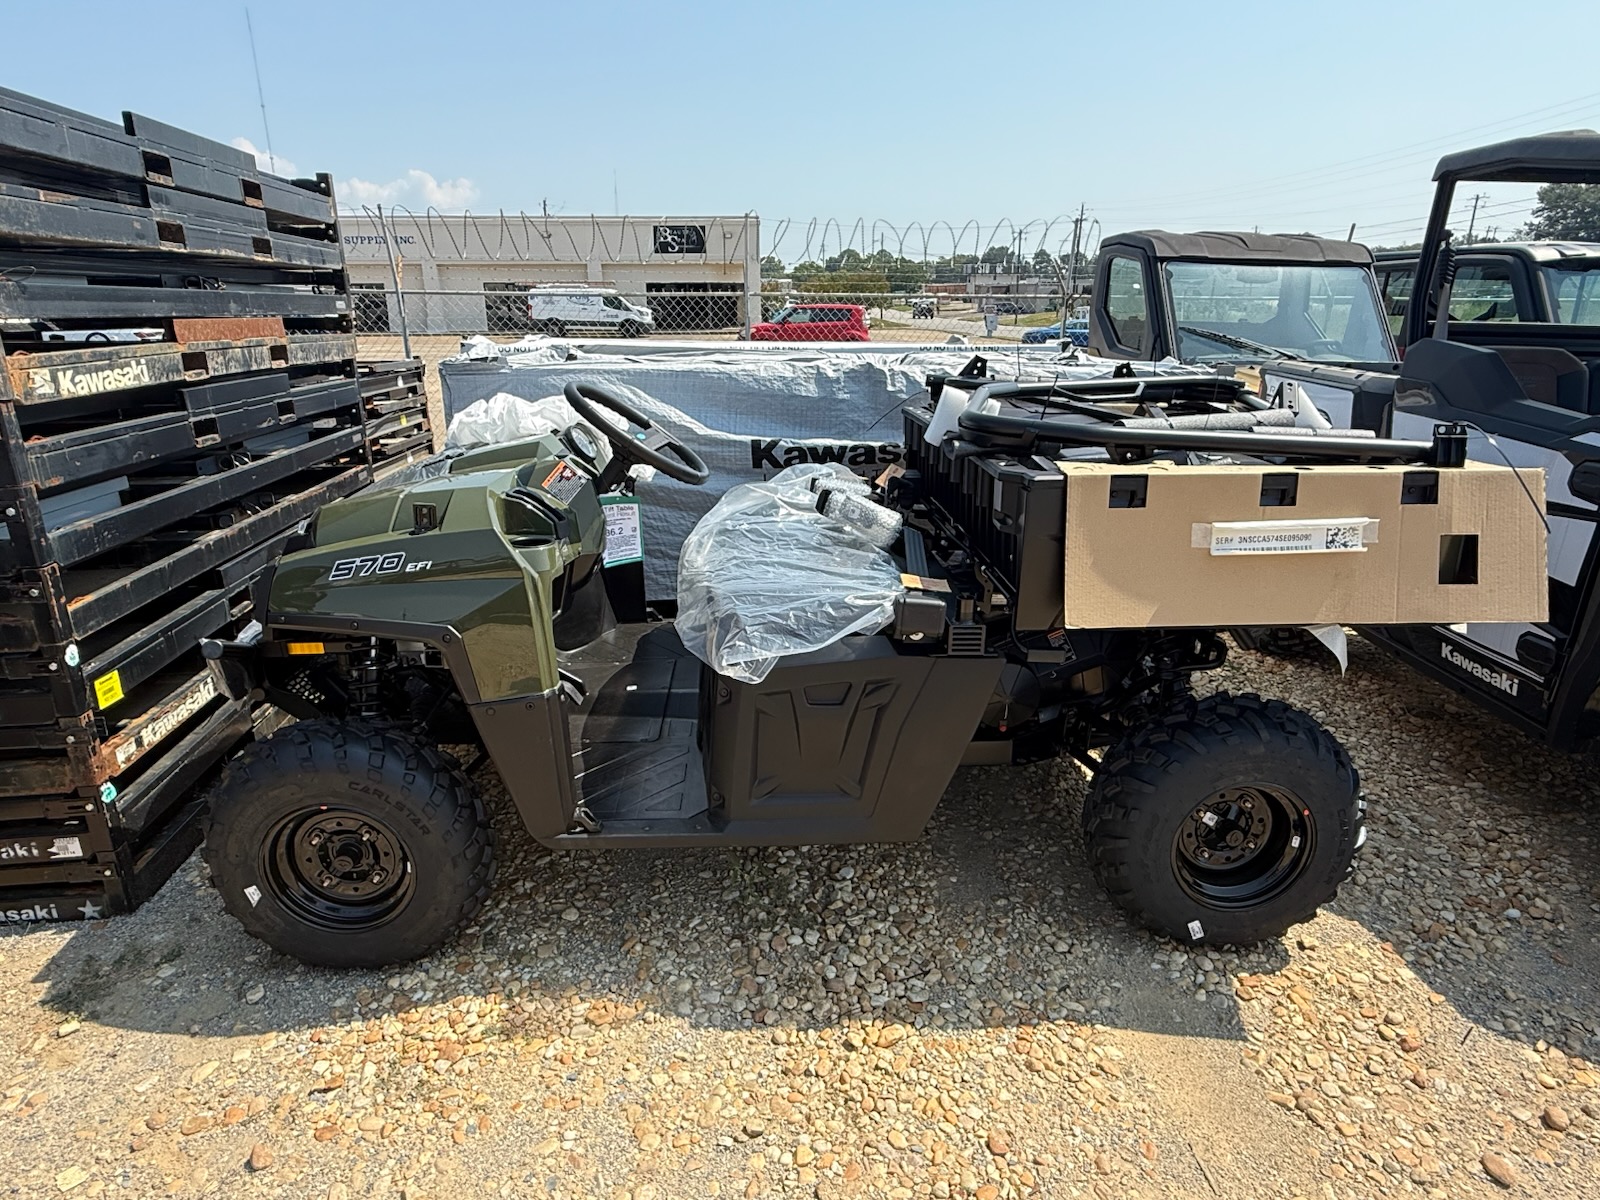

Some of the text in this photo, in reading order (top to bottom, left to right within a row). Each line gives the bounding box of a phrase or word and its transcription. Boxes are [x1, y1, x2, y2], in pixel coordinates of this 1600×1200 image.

[57, 358, 150, 396] Kawasaki
[750, 438, 906, 469] Kawas
[1215, 536, 1234, 545] SER#
[328, 552, 433, 581] 570 EFI
[1441, 642, 1519, 697] Kawasaki
[140, 675, 214, 749] Kawasaki
